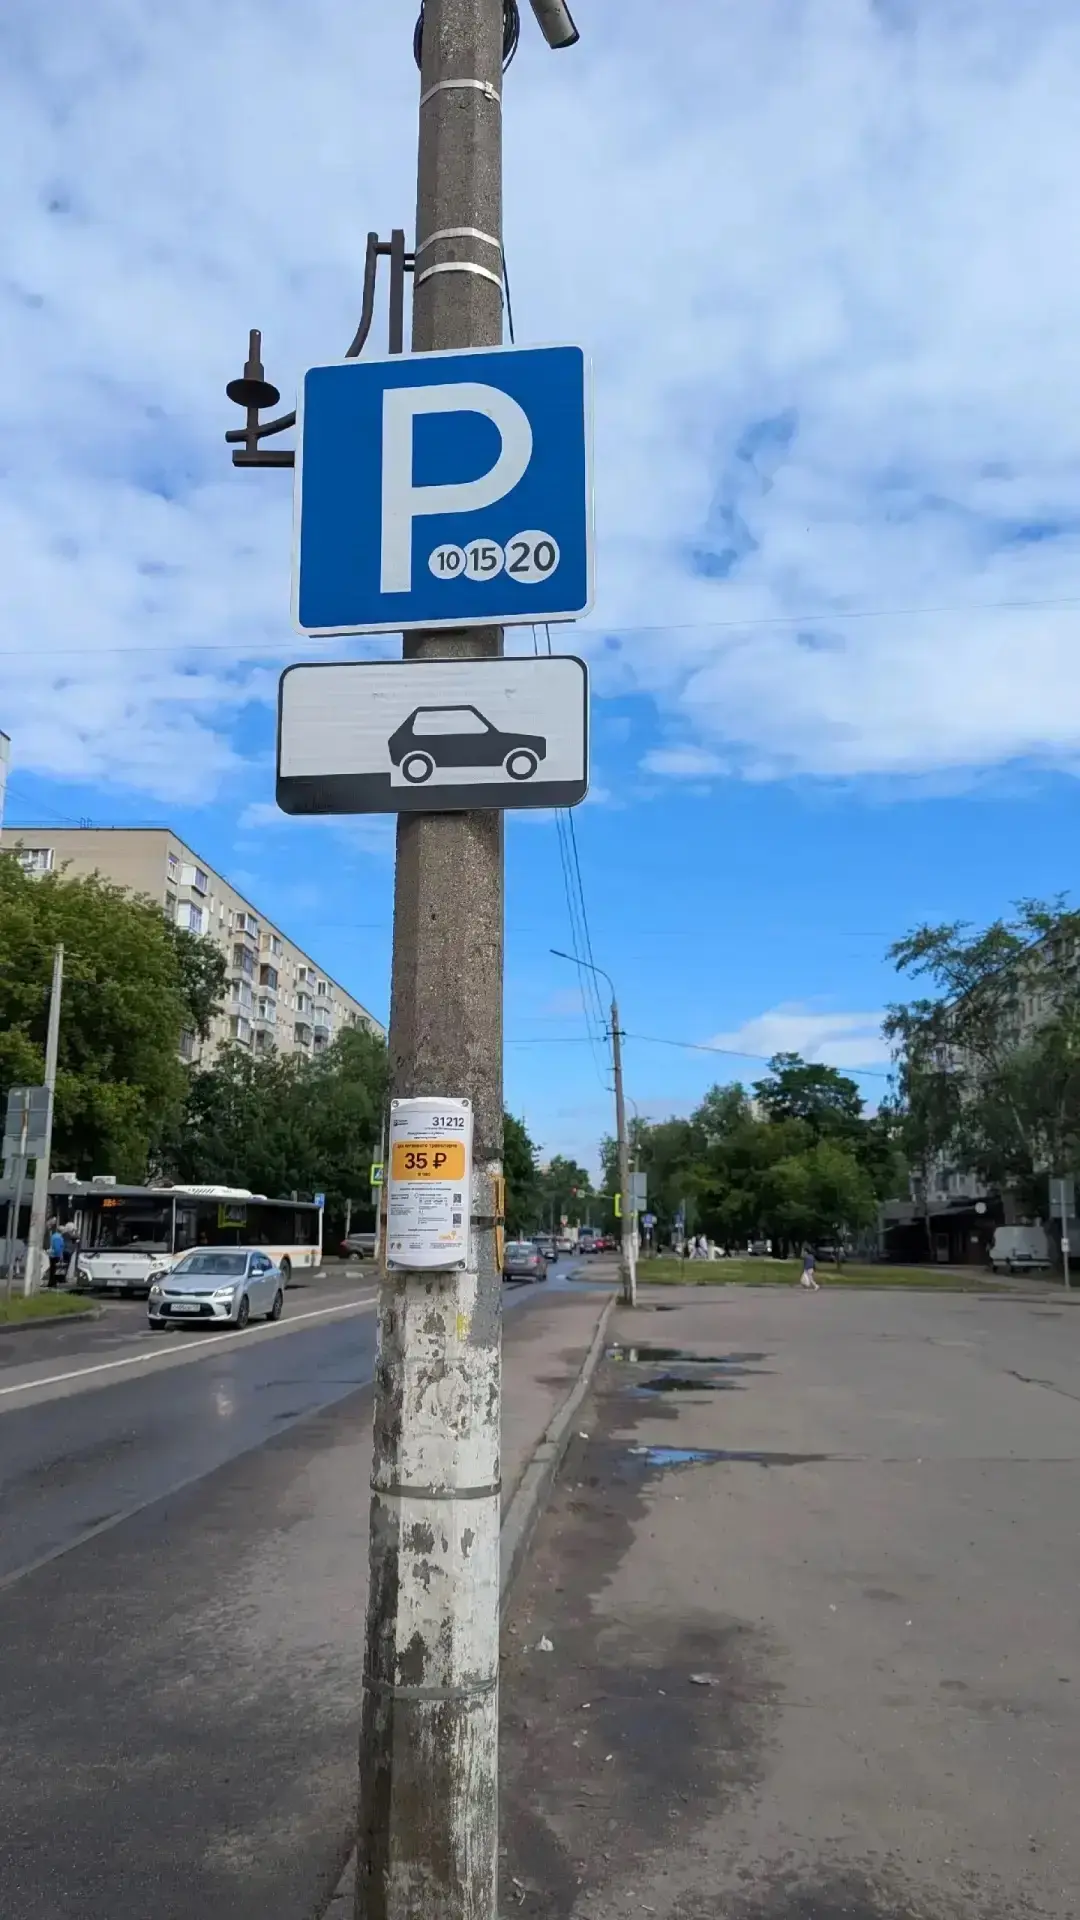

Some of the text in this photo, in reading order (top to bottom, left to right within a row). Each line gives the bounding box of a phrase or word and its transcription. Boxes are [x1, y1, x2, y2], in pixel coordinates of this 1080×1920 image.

[380, 382, 533, 594] P
[437, 541, 556, 572] 10 15 20
[432, 1116, 465, 1128] 31212
[404, 1152, 448, 1170] 35 ₽
